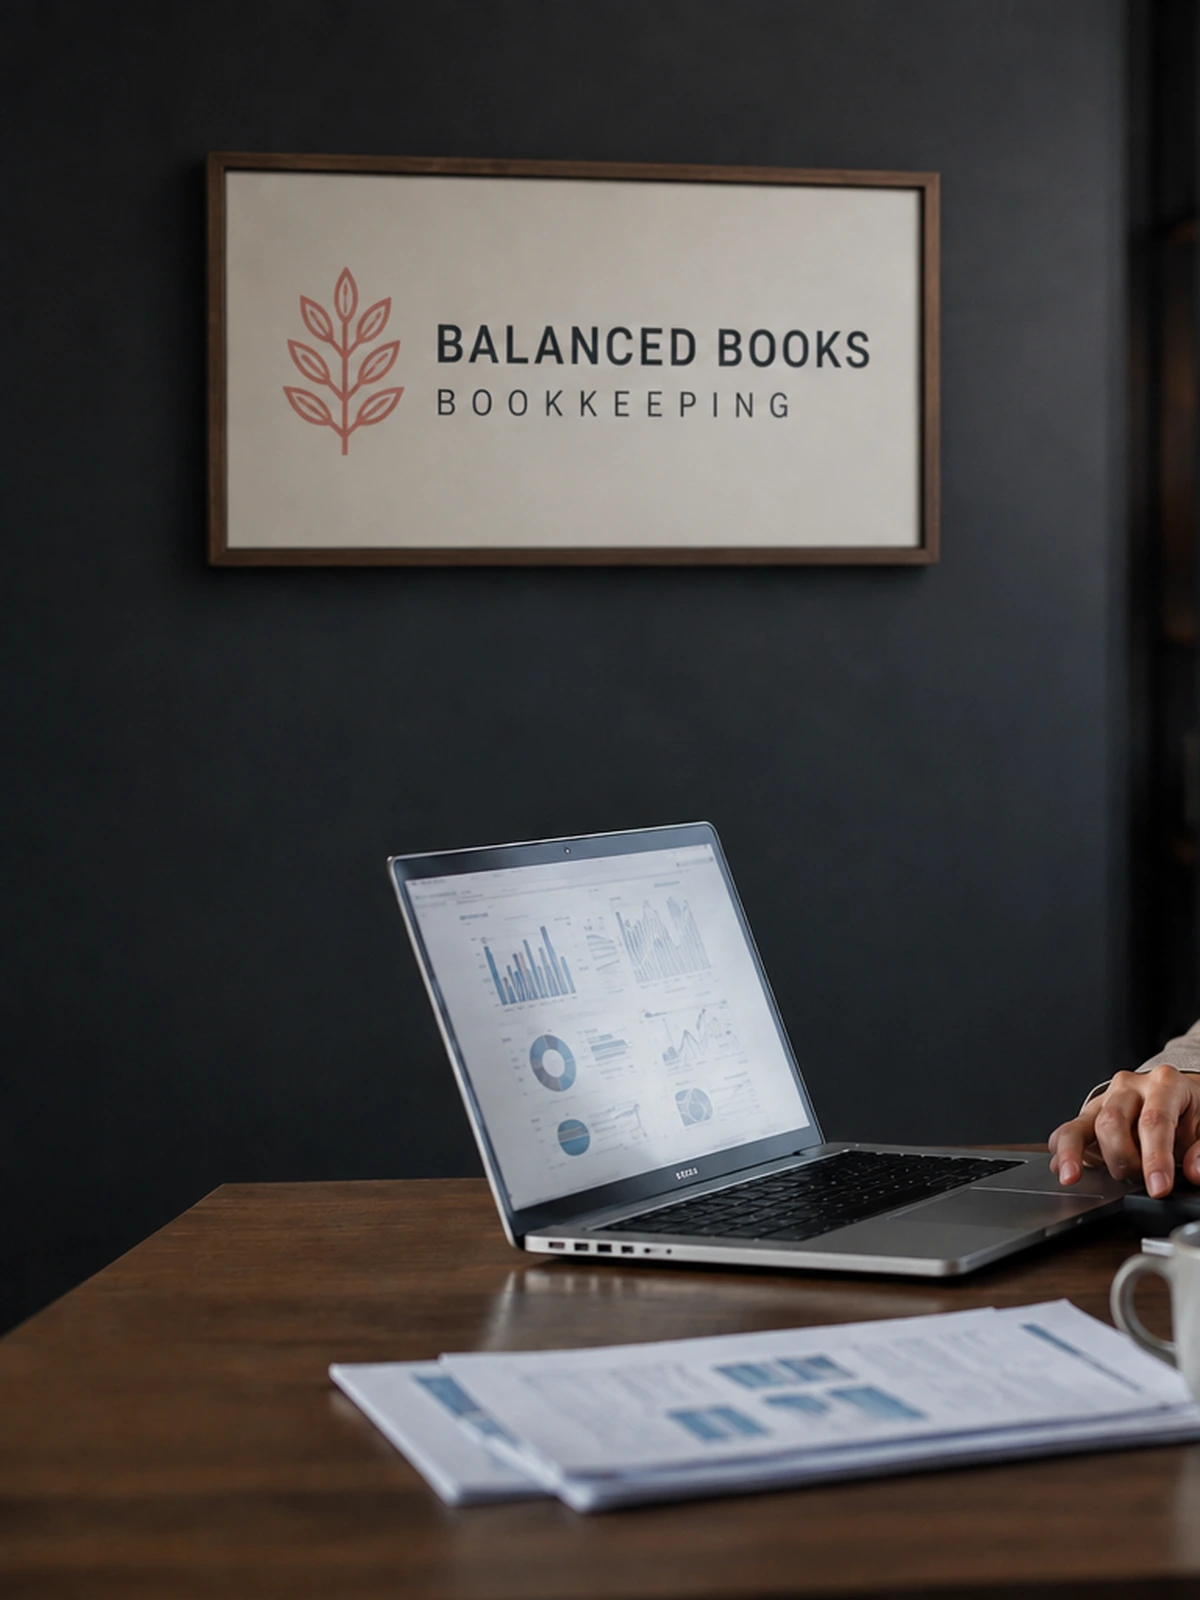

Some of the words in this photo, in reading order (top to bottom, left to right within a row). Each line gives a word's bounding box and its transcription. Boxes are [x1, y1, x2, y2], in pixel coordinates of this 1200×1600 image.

[436, 322, 697, 367] BALANCED
[717, 328, 870, 369] BOOKS
[436, 388, 790, 419] BOOKKEEPING
